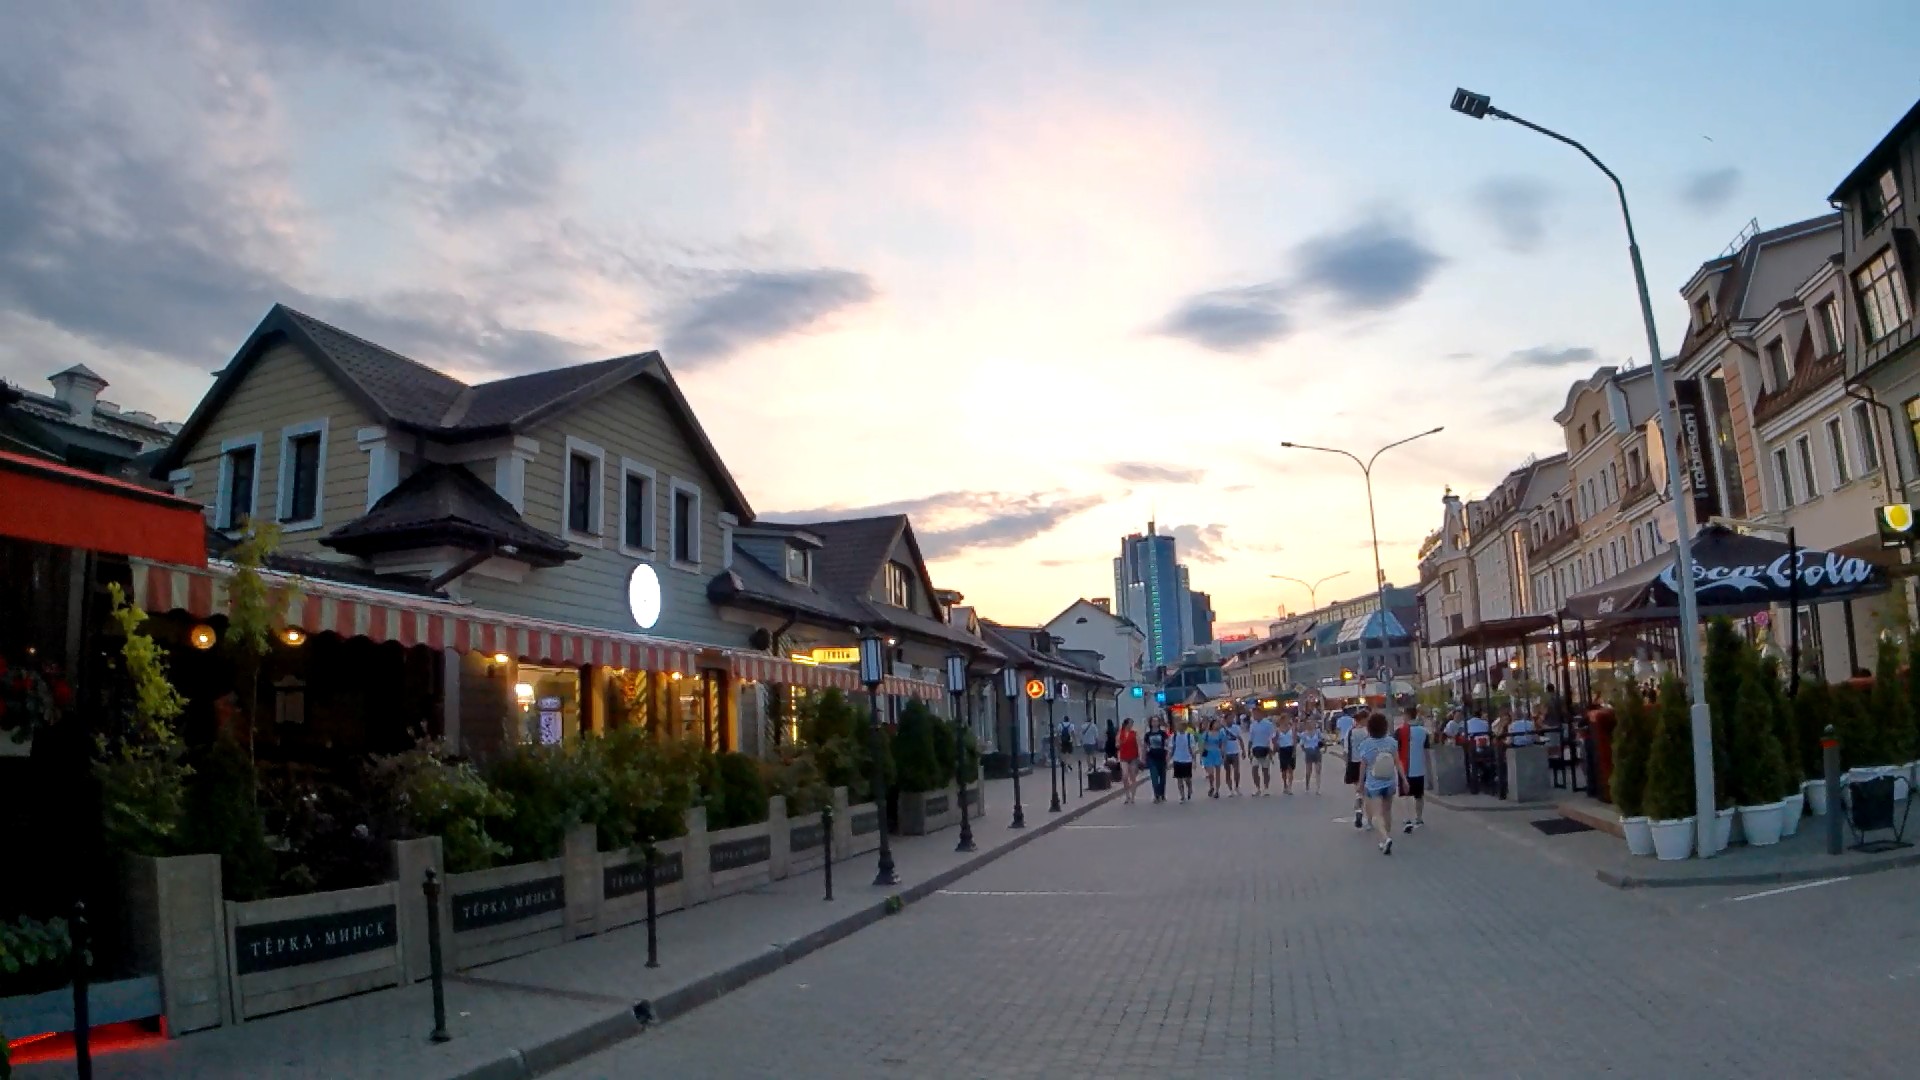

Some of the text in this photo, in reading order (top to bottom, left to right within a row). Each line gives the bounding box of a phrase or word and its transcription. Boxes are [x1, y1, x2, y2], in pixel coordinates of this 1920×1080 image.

[1660, 548, 1873, 592] Coca-Cola
[249, 920, 386, 958] ТЁРКА МИНСК
